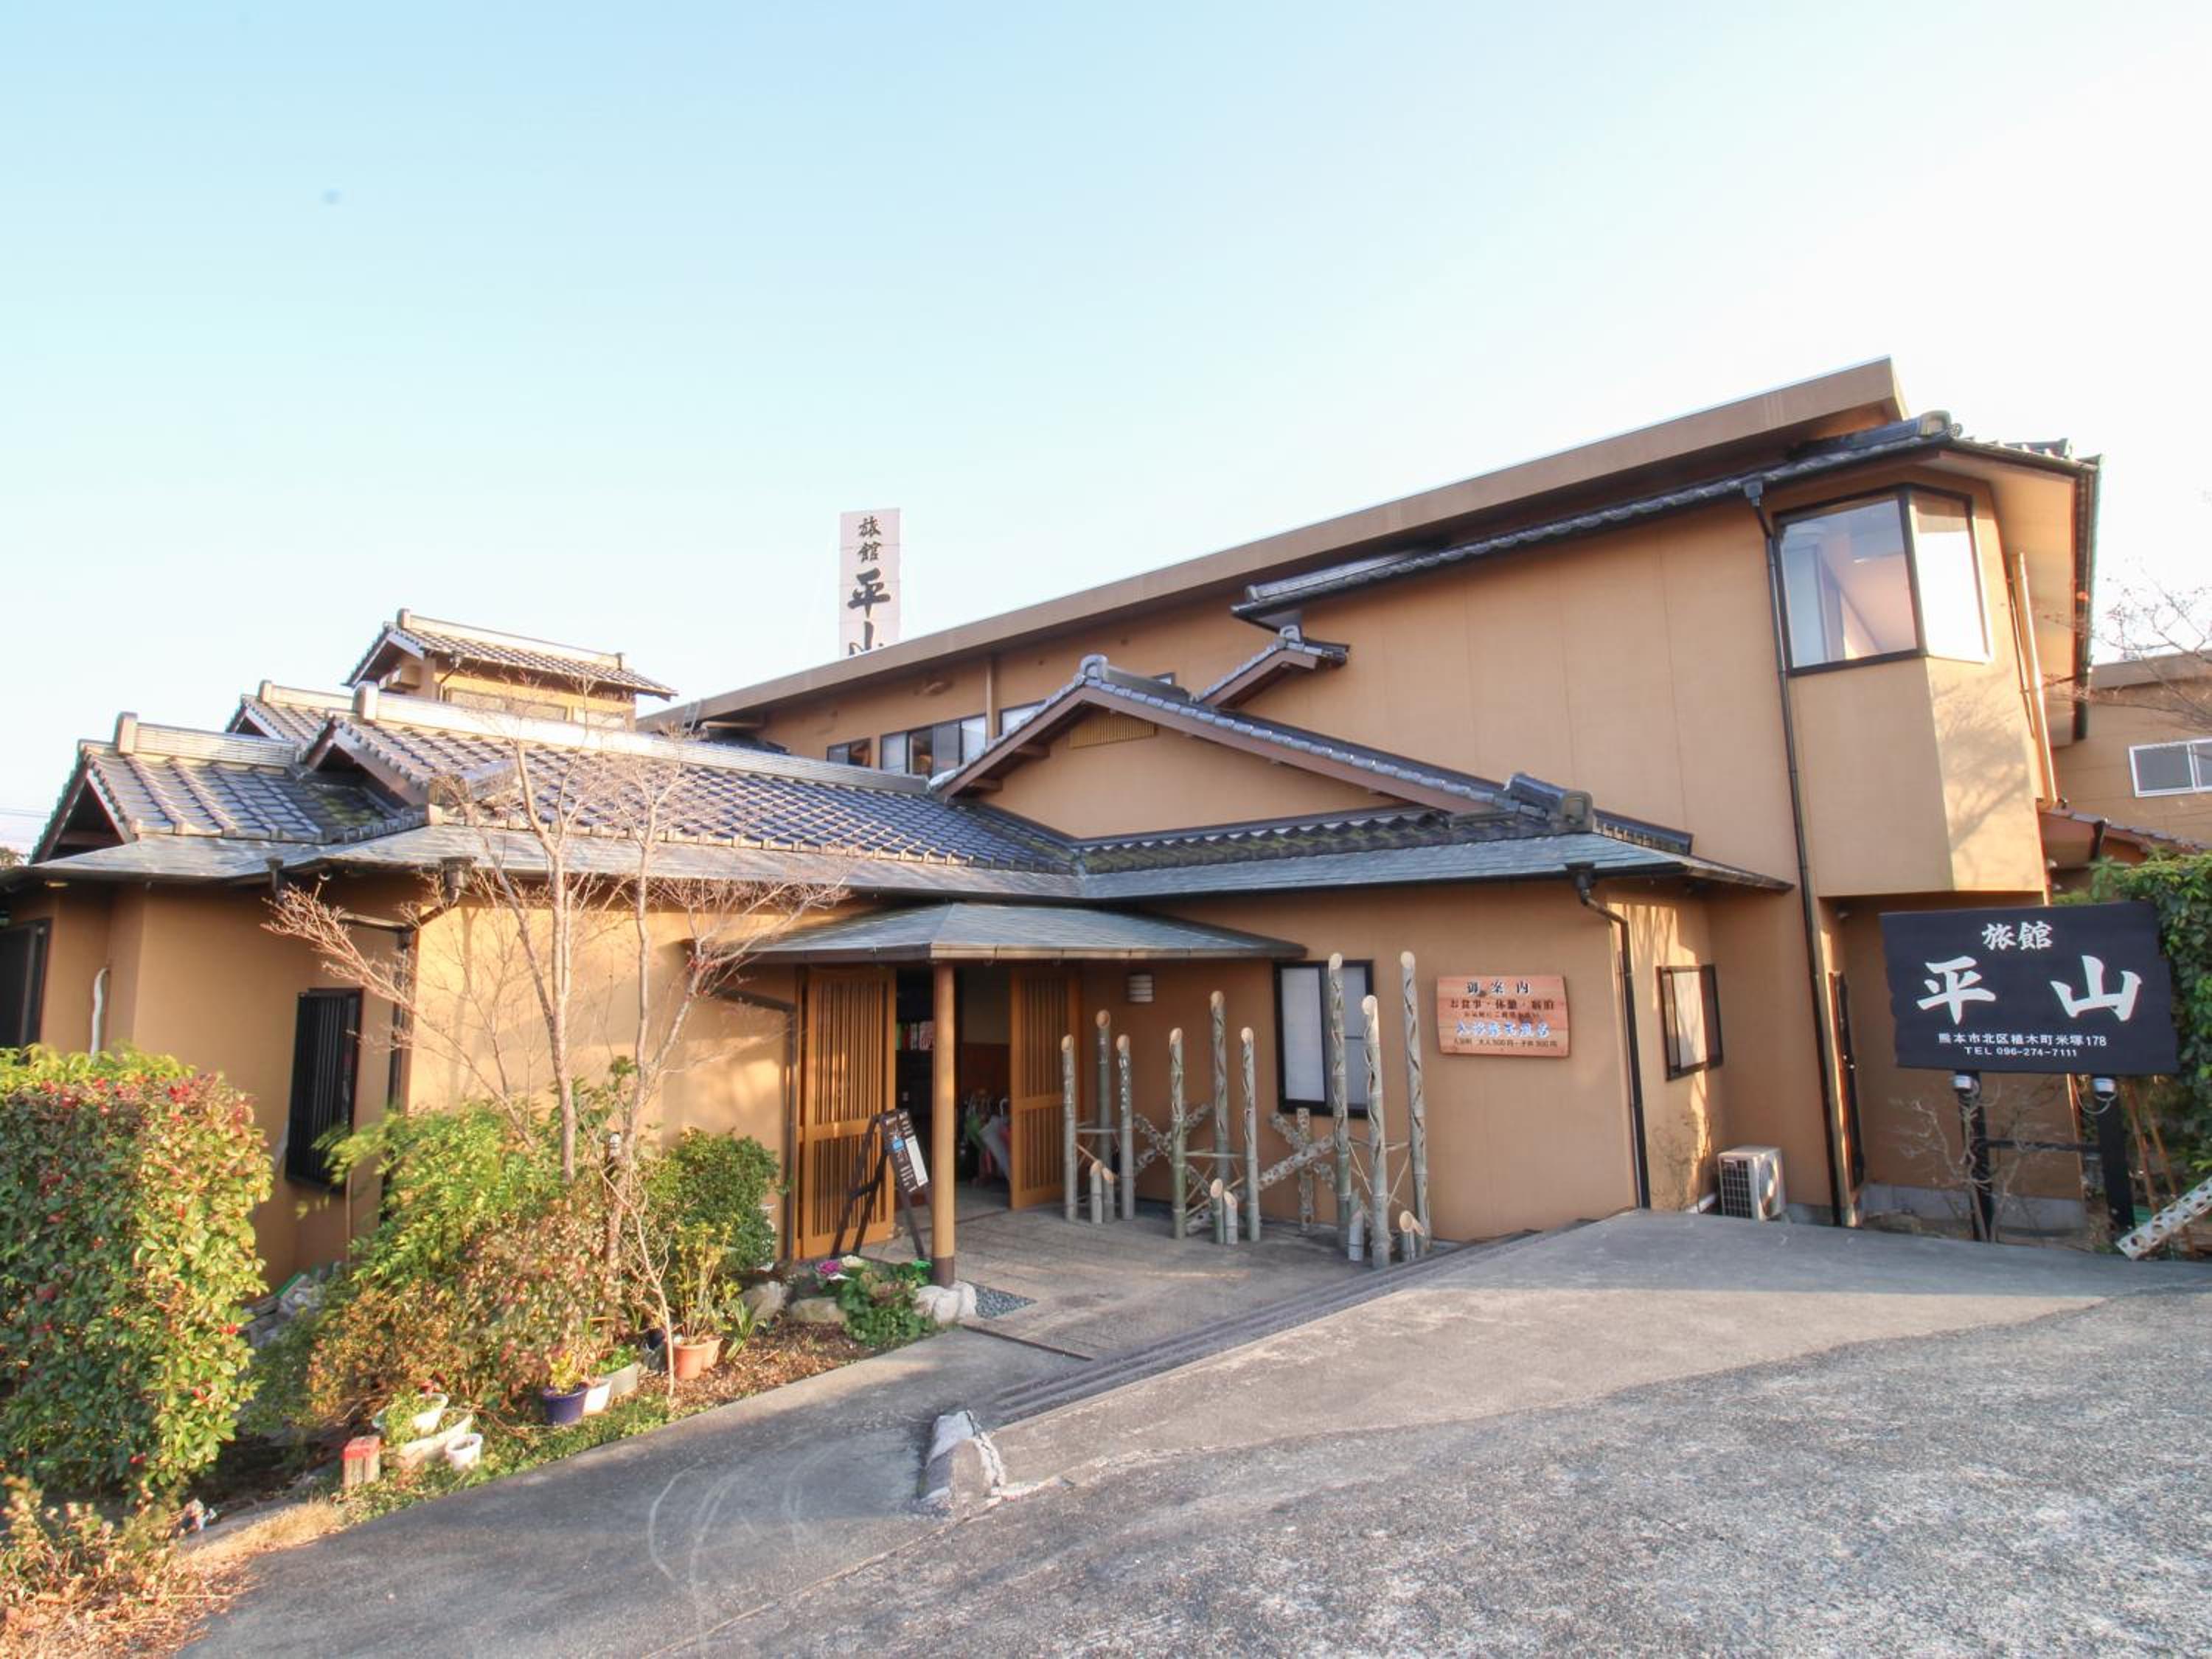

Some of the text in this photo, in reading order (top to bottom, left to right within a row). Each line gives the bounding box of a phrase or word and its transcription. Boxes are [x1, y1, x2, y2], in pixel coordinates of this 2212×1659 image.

[858, 516, 881, 563] 旅館
[1982, 920, 2053, 950] 旅館
[1964, 1046, 2077, 1057] TEL 096-274-7111
